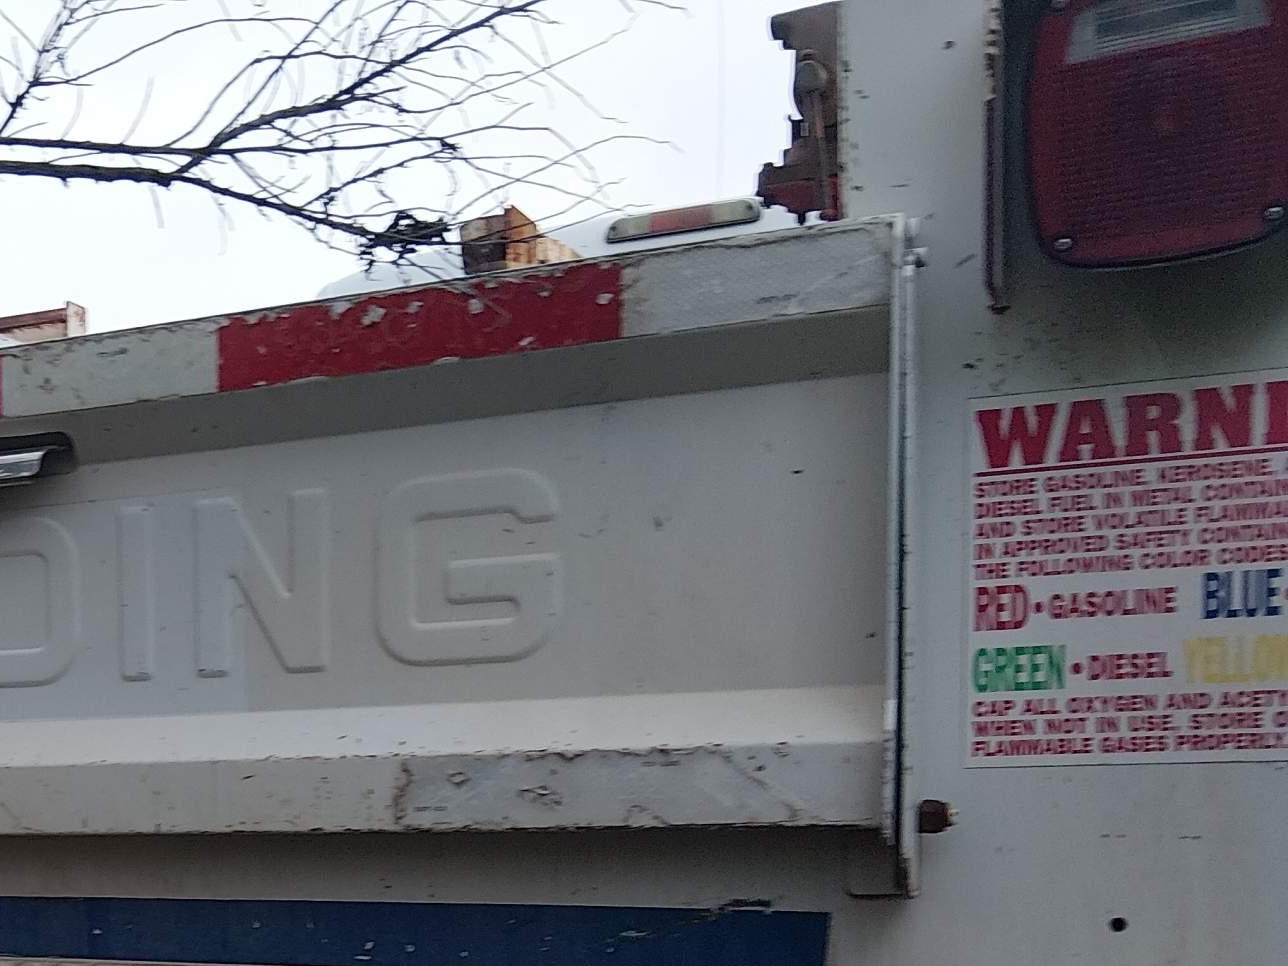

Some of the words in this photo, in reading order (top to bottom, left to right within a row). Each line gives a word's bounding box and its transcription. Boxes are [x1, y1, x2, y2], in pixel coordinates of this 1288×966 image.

[975, 478, 1039, 498] STORE
[975, 498, 1043, 519] DIESEL
[1048, 494, 1096, 513] FUEL
[1104, 492, 1124, 509] IN
[1133, 486, 1194, 506] METAL
[975, 521, 1016, 539] AND
[1021, 515, 1086, 536] STORE
[1093, 508, 1187, 530] VOLATILE
[1193, 501, 1288, 523] FLAMMA
[975, 543, 995, 560] IN
[1001, 534, 1108, 558] APPROVED
[1113, 529, 1191, 551] SAFETY
[975, 562, 1010, 580] THE
[1015, 554, 1134, 577] FOLLOWING
[1139, 549, 1211, 571] COLOR
[973, 584, 1030, 632] RED
[1049, 586, 1178, 619] GASOLINE
[1200, 568, 1283, 620] BLUE
[973, 645, 1066, 693] GREEN
[1086, 652, 1174, 681] DIESEL
[971, 700, 1016, 717] CAP
[1021, 698, 1060, 715] ALL
[1067, 695, 1157, 714] OXYGEN
[1164, 692, 1213, 711] AND
[971, 719, 1036, 737] WHEN
[1043, 717, 1089, 734] NOT
[1097, 716, 1119, 733] IN
[1190, 711, 1264, 731] STORE
[971, 736, 1094, 758] FLAMMABLE
[1100, 735, 1169, 754] GASES
